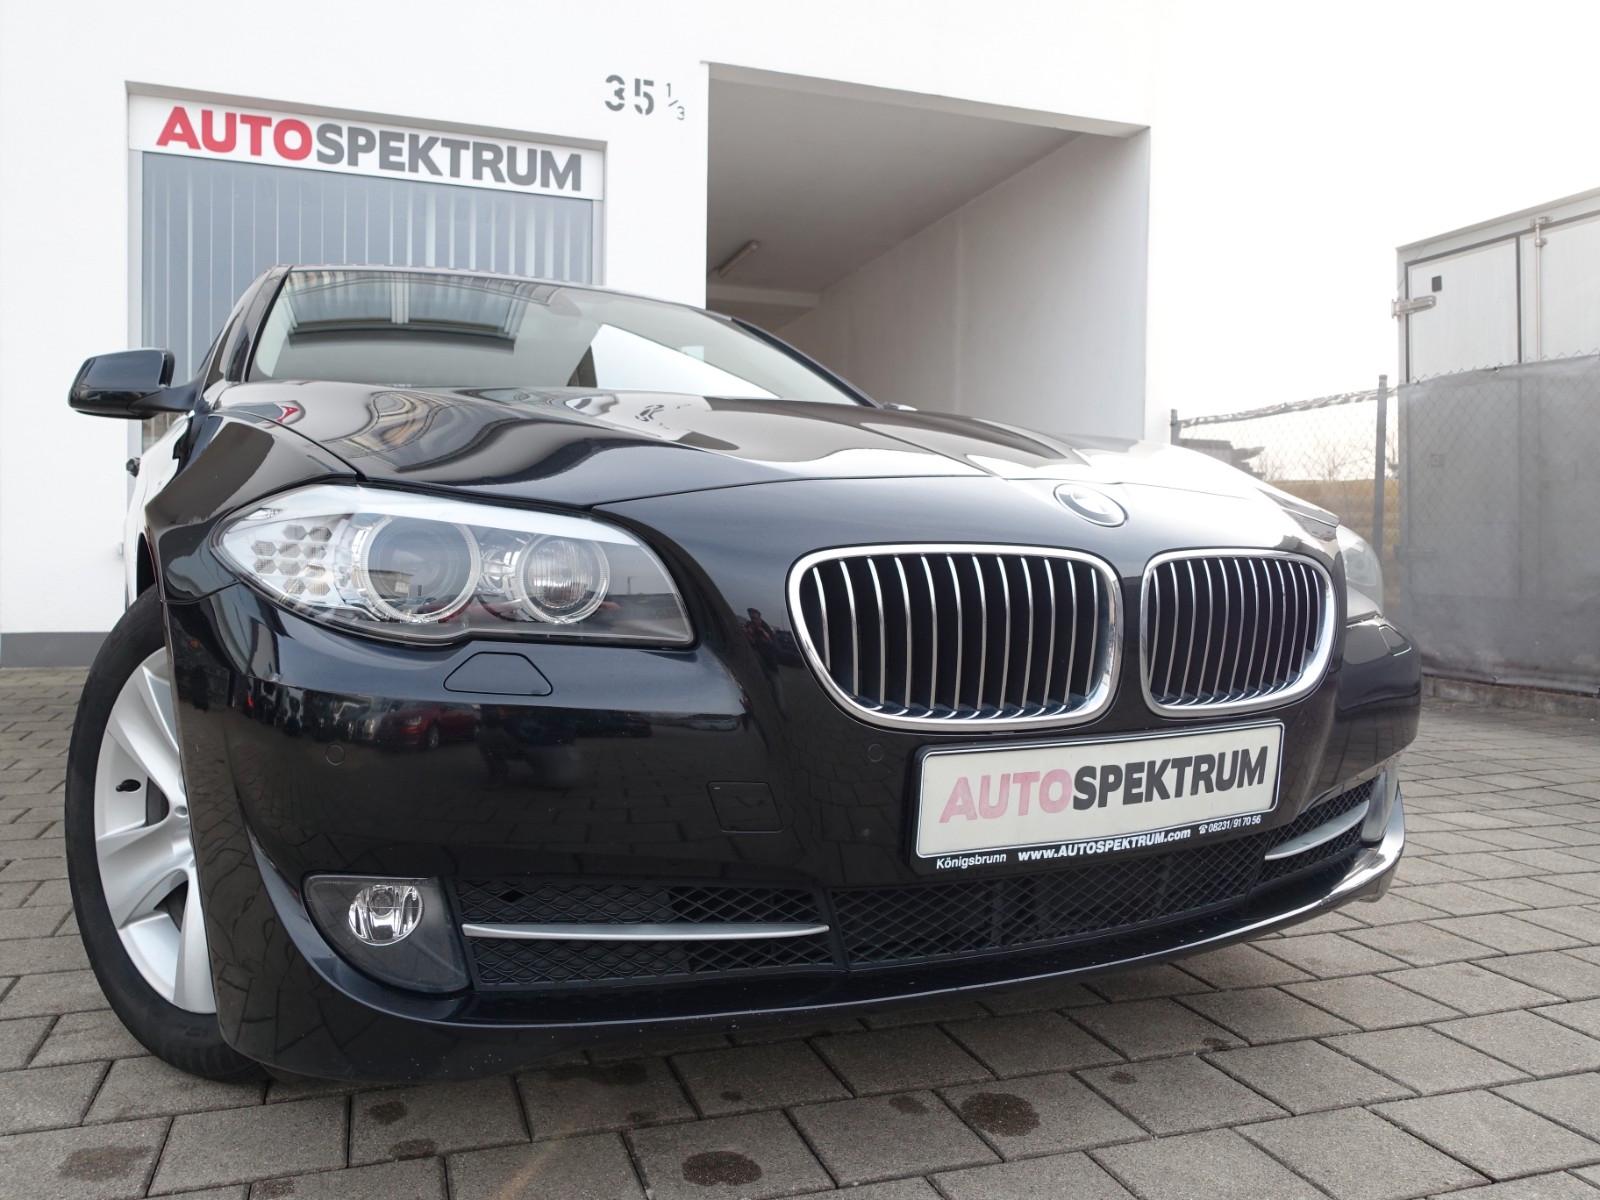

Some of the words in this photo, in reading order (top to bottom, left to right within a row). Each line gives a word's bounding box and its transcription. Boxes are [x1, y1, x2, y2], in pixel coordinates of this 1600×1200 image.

[605, 74, 655, 116] 35
[156, 105, 582, 192] AUTOSPEKTRUM
[938, 745, 1269, 824] AUTOSPEKTRUM
[936, 852, 1007, 870] Königsbrunn
[1018, 827, 1191, 862] www.AUTOSPEKTRUM.com
